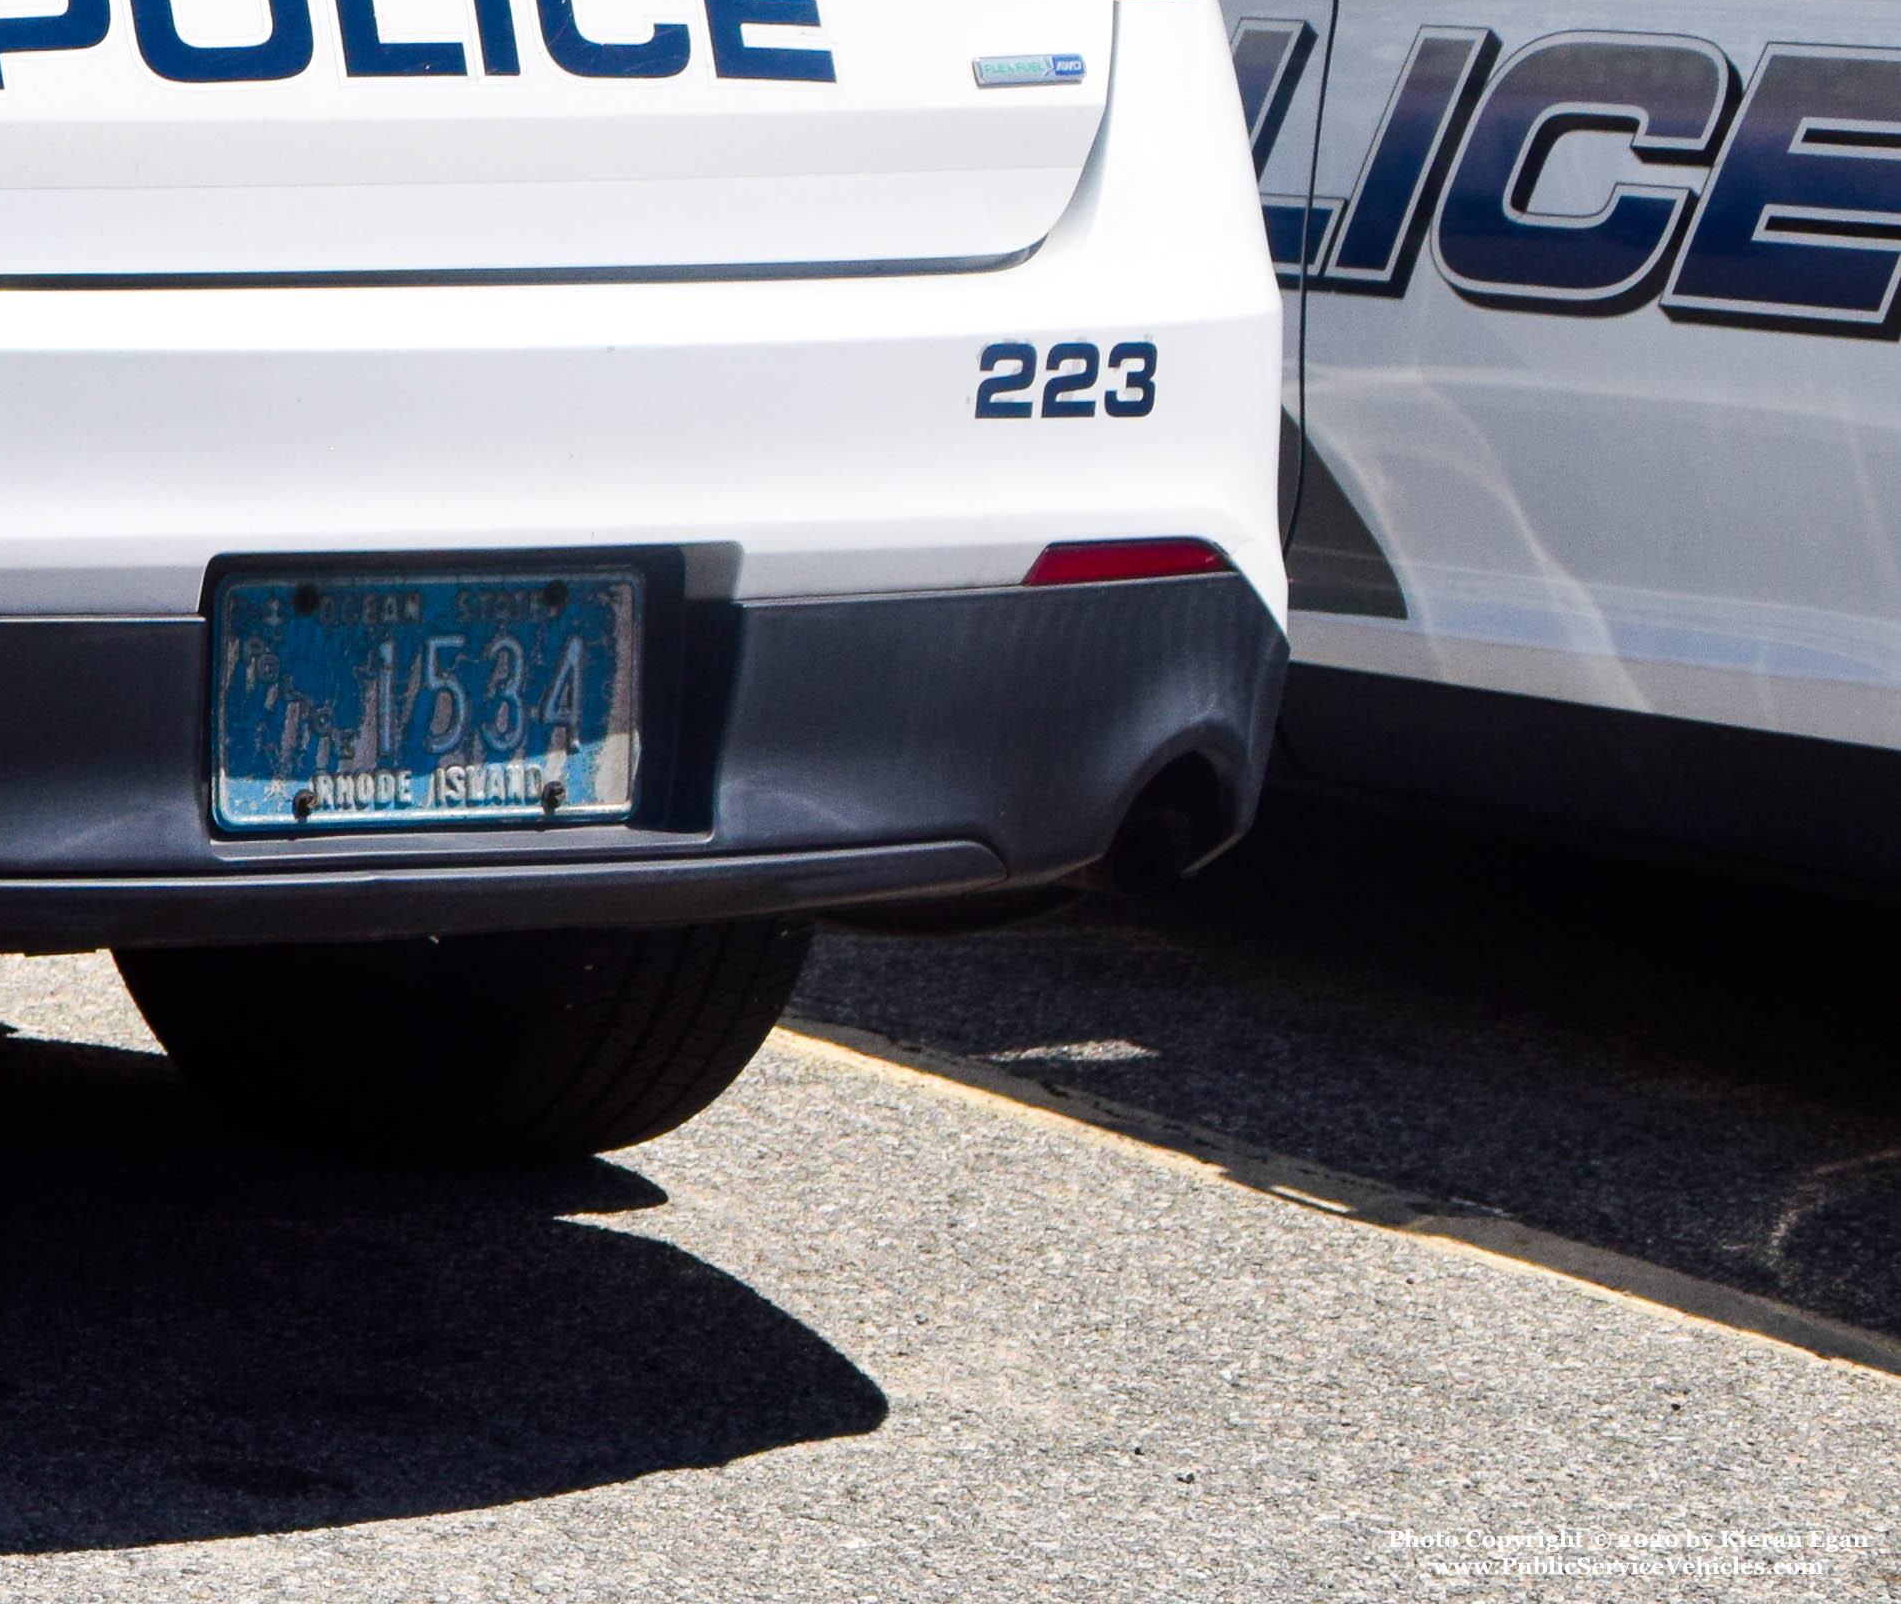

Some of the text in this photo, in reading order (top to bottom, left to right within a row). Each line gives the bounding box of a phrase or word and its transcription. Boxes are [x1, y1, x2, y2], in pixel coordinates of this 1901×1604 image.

[1231, 17, 1901, 342] LICE
[975, 342, 1158, 419] 223
[377, 633, 587, 757] 1534
[313, 763, 545, 811] RHODE ISLAND
